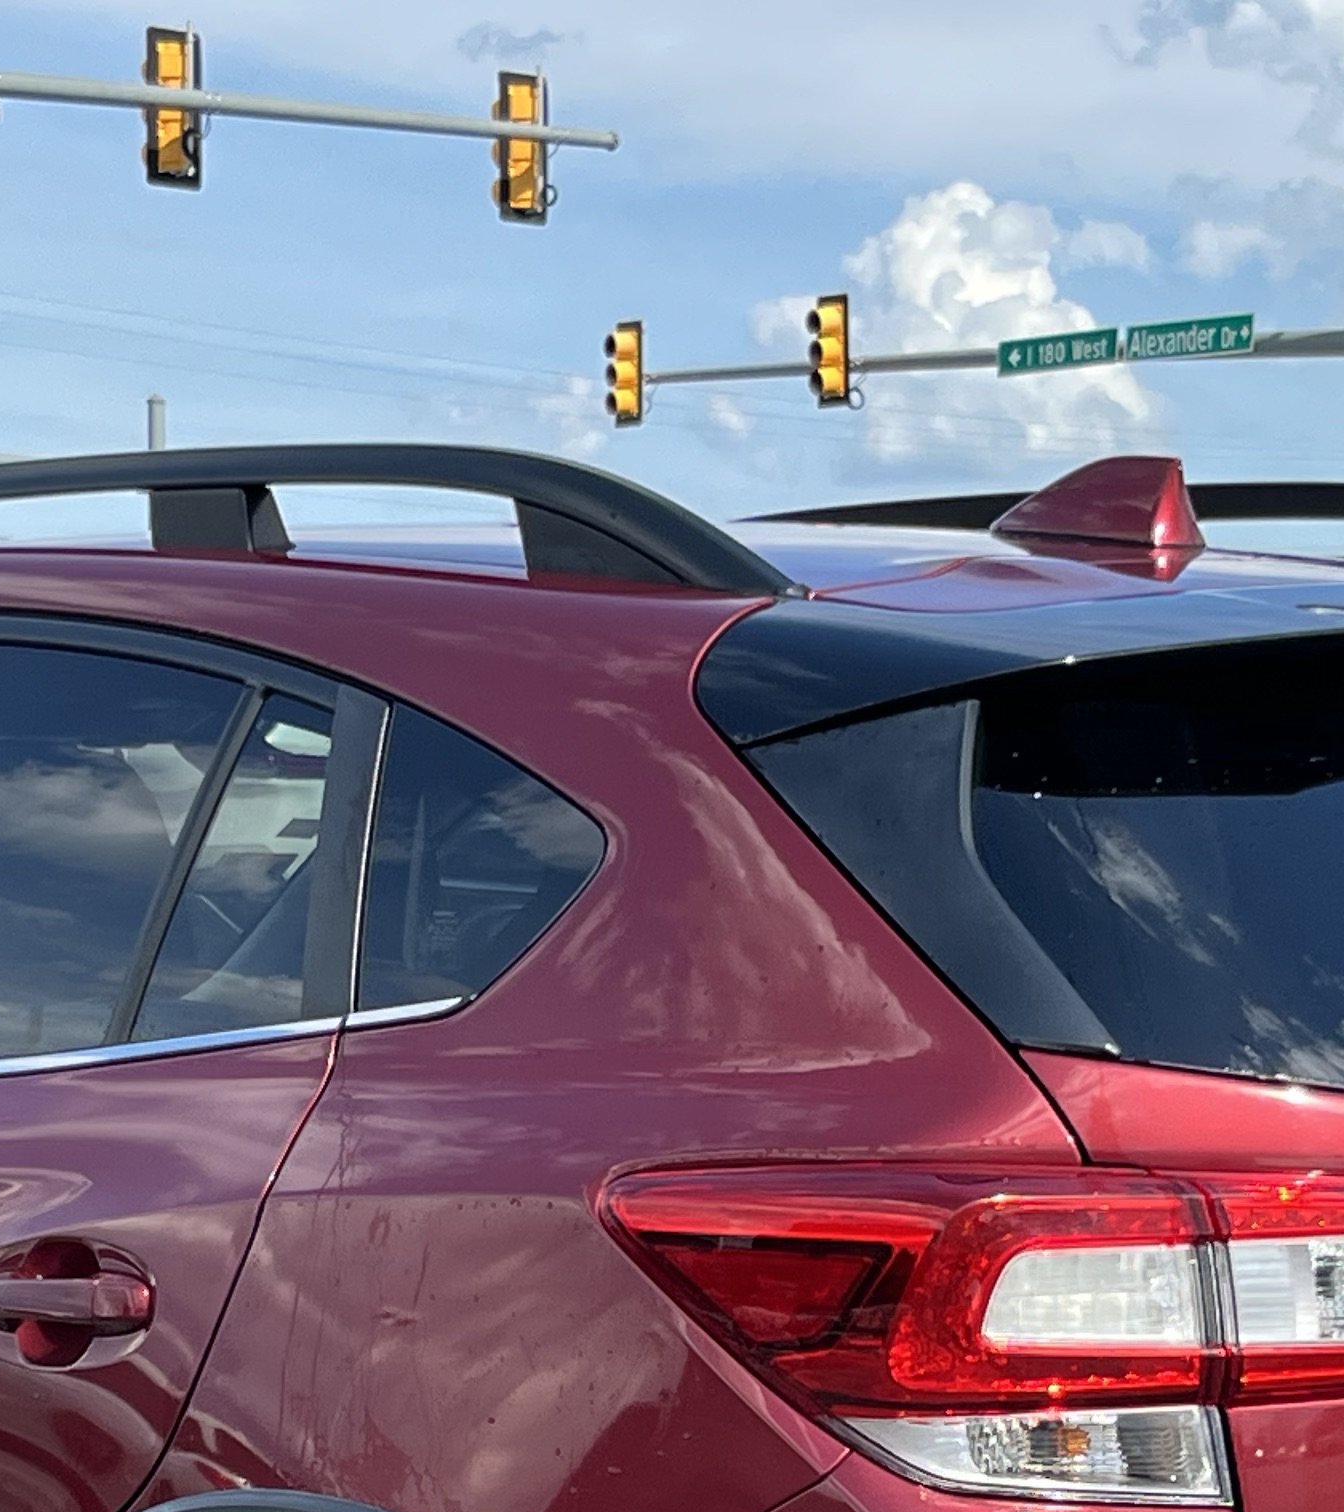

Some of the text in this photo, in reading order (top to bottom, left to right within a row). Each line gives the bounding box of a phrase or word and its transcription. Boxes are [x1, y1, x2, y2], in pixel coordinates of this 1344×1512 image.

[1038, 343, 1065, 365] 180
[1071, 338, 1107, 361] West
[1129, 324, 1238, 358] Alexander Dr
